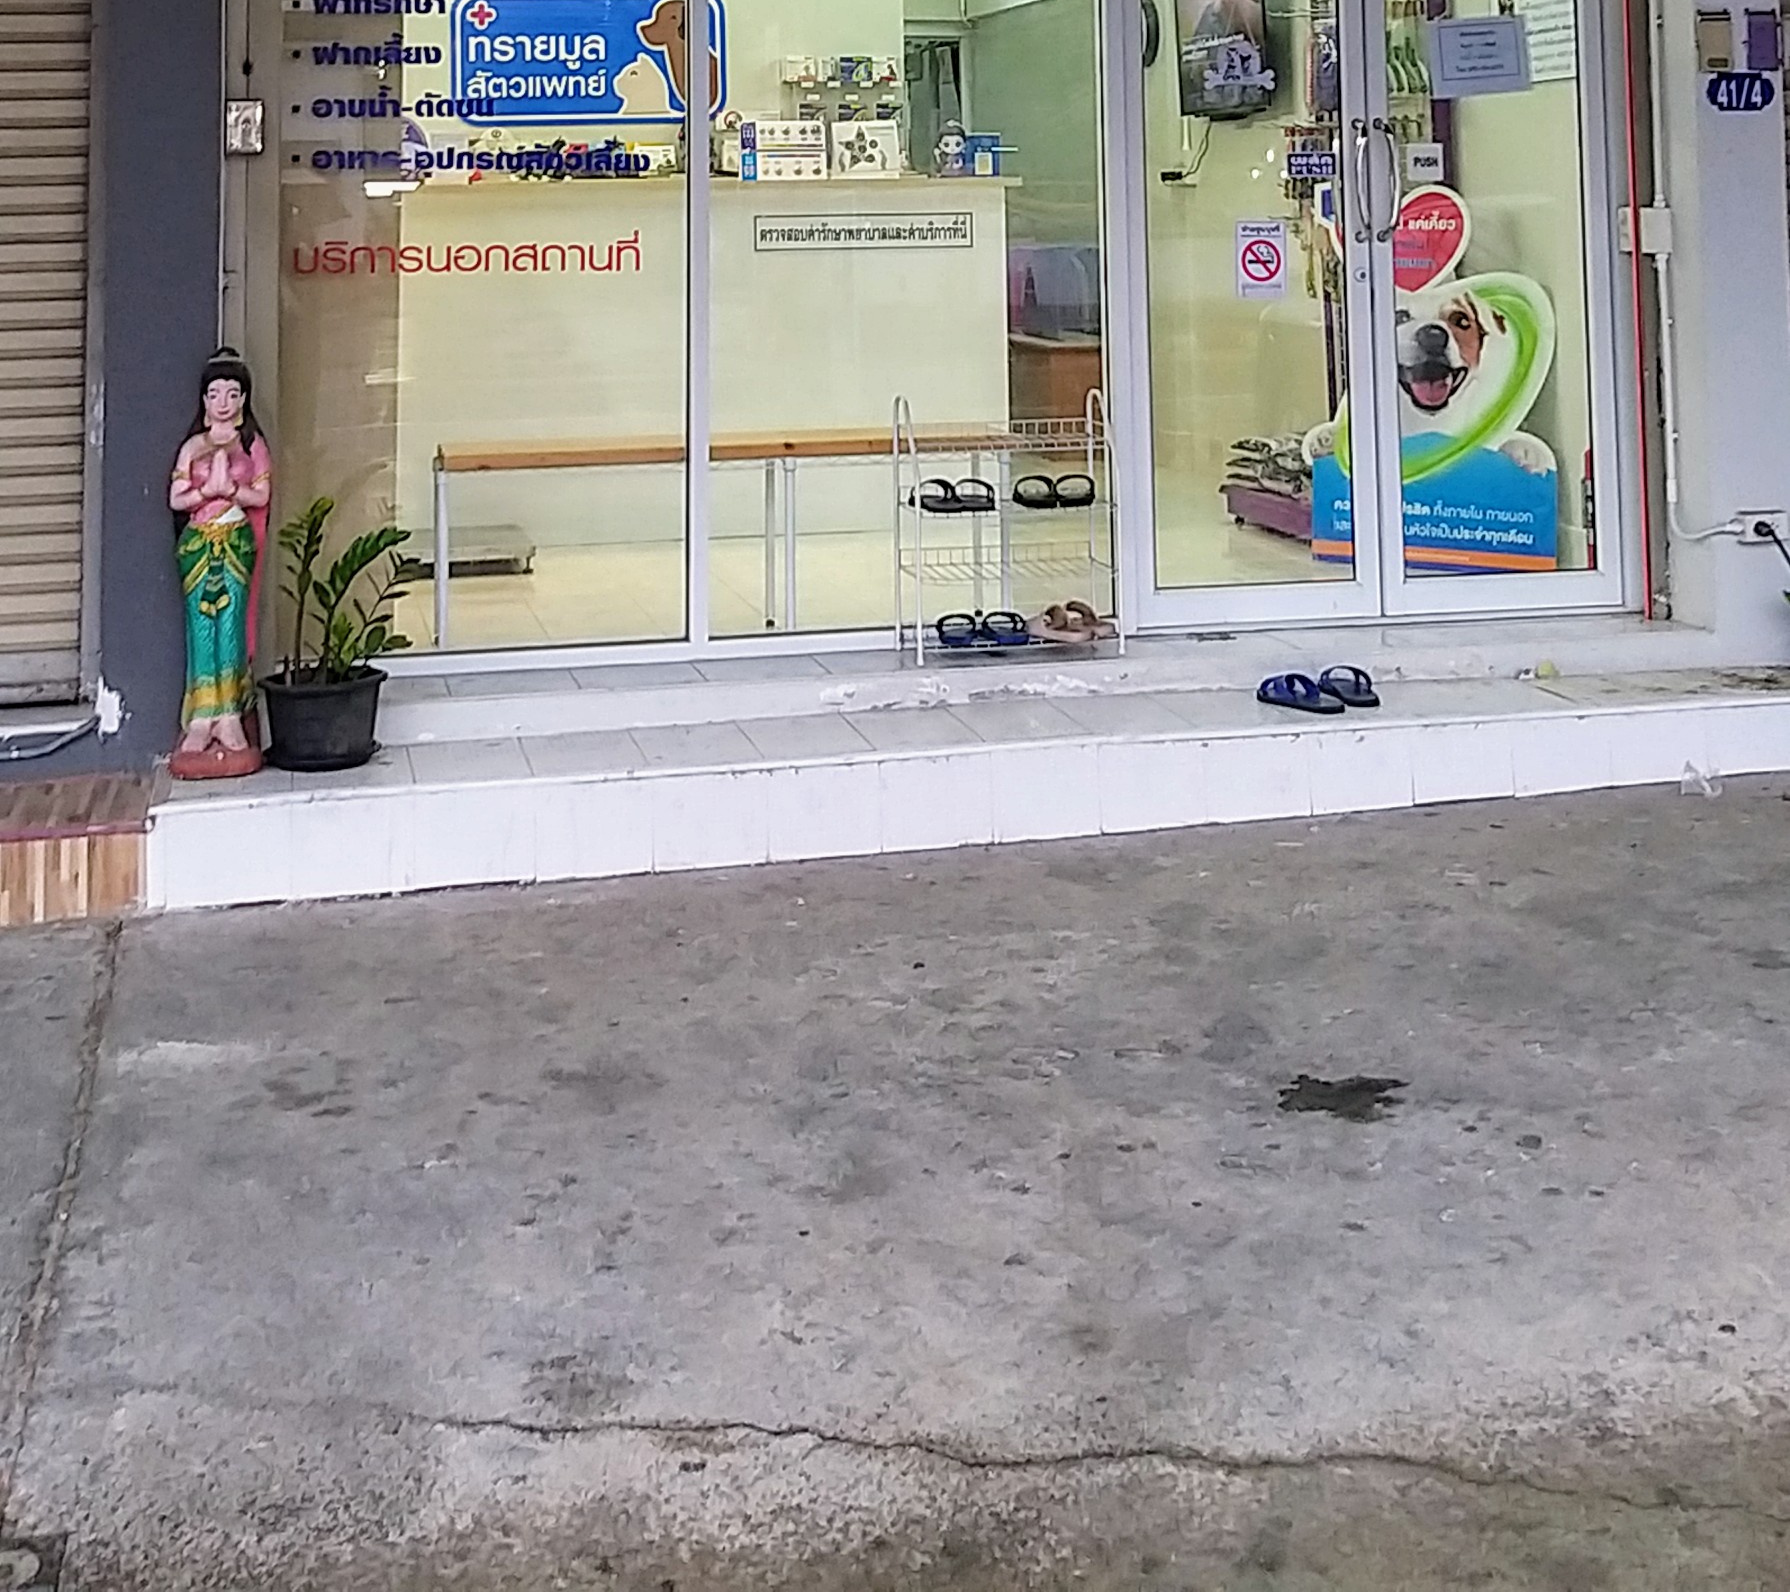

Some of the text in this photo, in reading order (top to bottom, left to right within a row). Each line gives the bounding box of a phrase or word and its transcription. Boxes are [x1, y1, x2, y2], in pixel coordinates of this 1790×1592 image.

[468, 33, 607, 71] ทรายมูล
[466, 69, 607, 99] สัตวแพทย์
[1717, 77, 1763, 109] 41/4
[1413, 157, 1439, 168] PUSH
[293, 230, 642, 275] บริการนอกสถานที่
